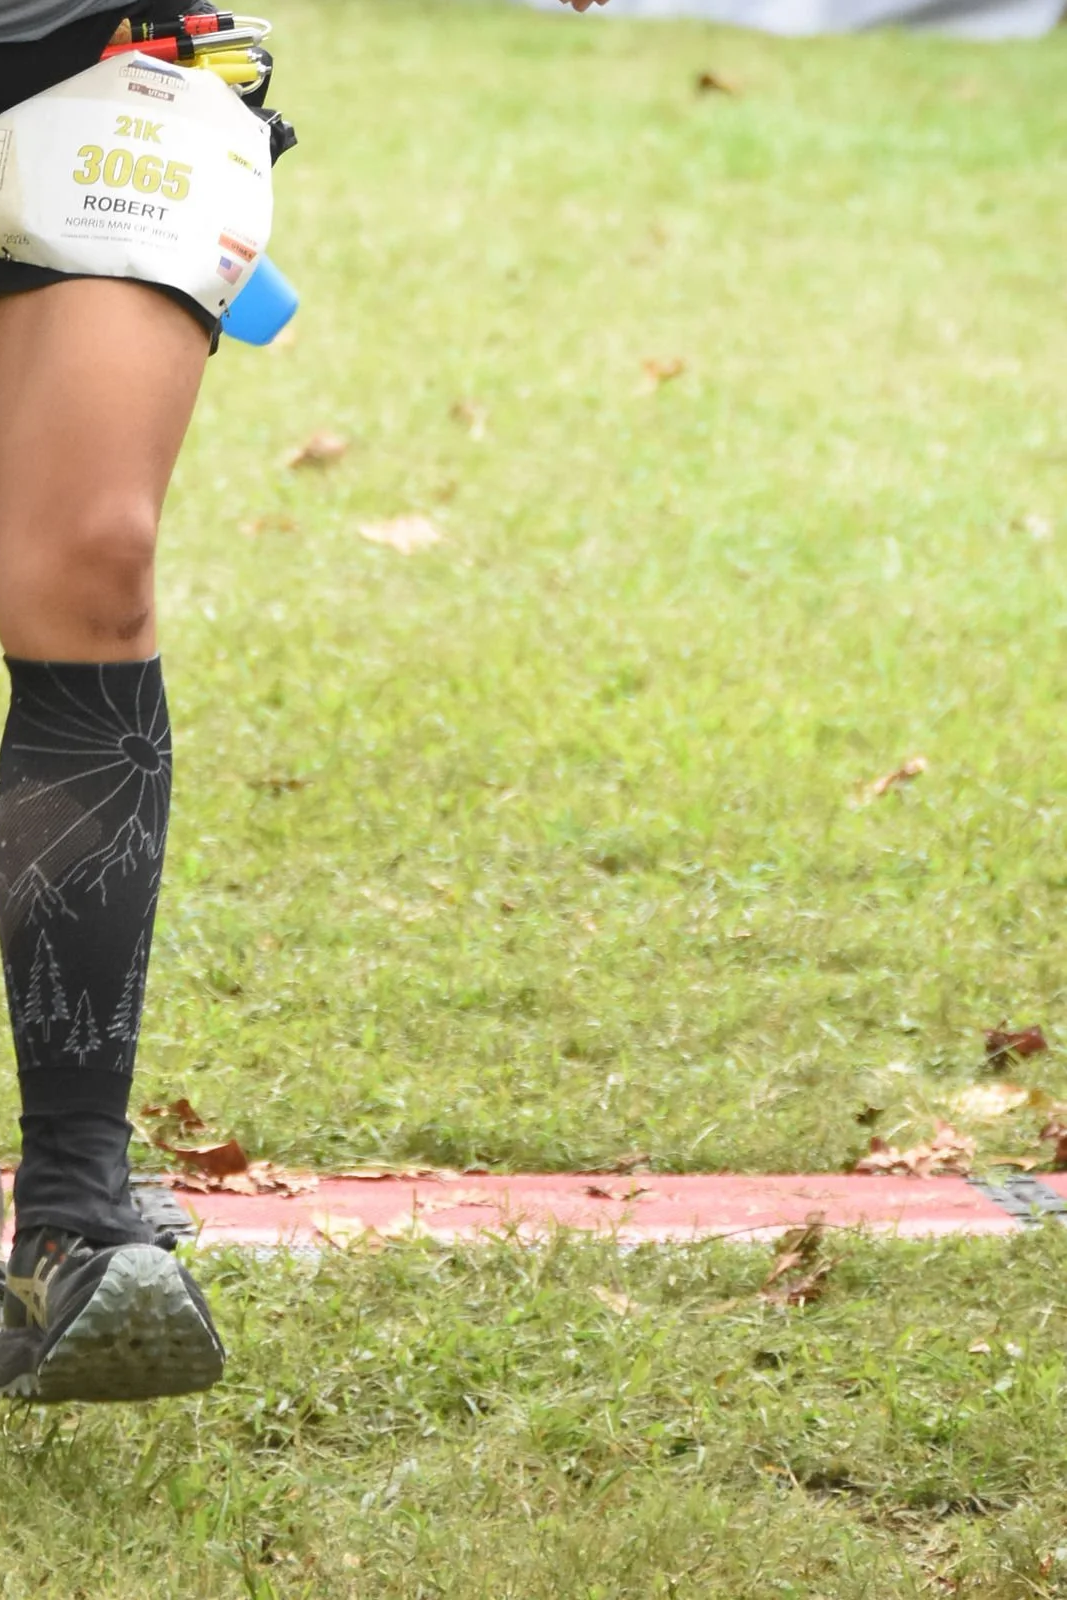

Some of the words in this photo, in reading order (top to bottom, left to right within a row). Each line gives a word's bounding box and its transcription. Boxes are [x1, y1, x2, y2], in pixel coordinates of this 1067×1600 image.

[114, 115, 165, 145] 21K
[72, 145, 194, 201] 3065
[83, 195, 170, 221] ROBERT
[65, 217, 105, 229] NORRIS
[107, 220, 132, 232] MAN
